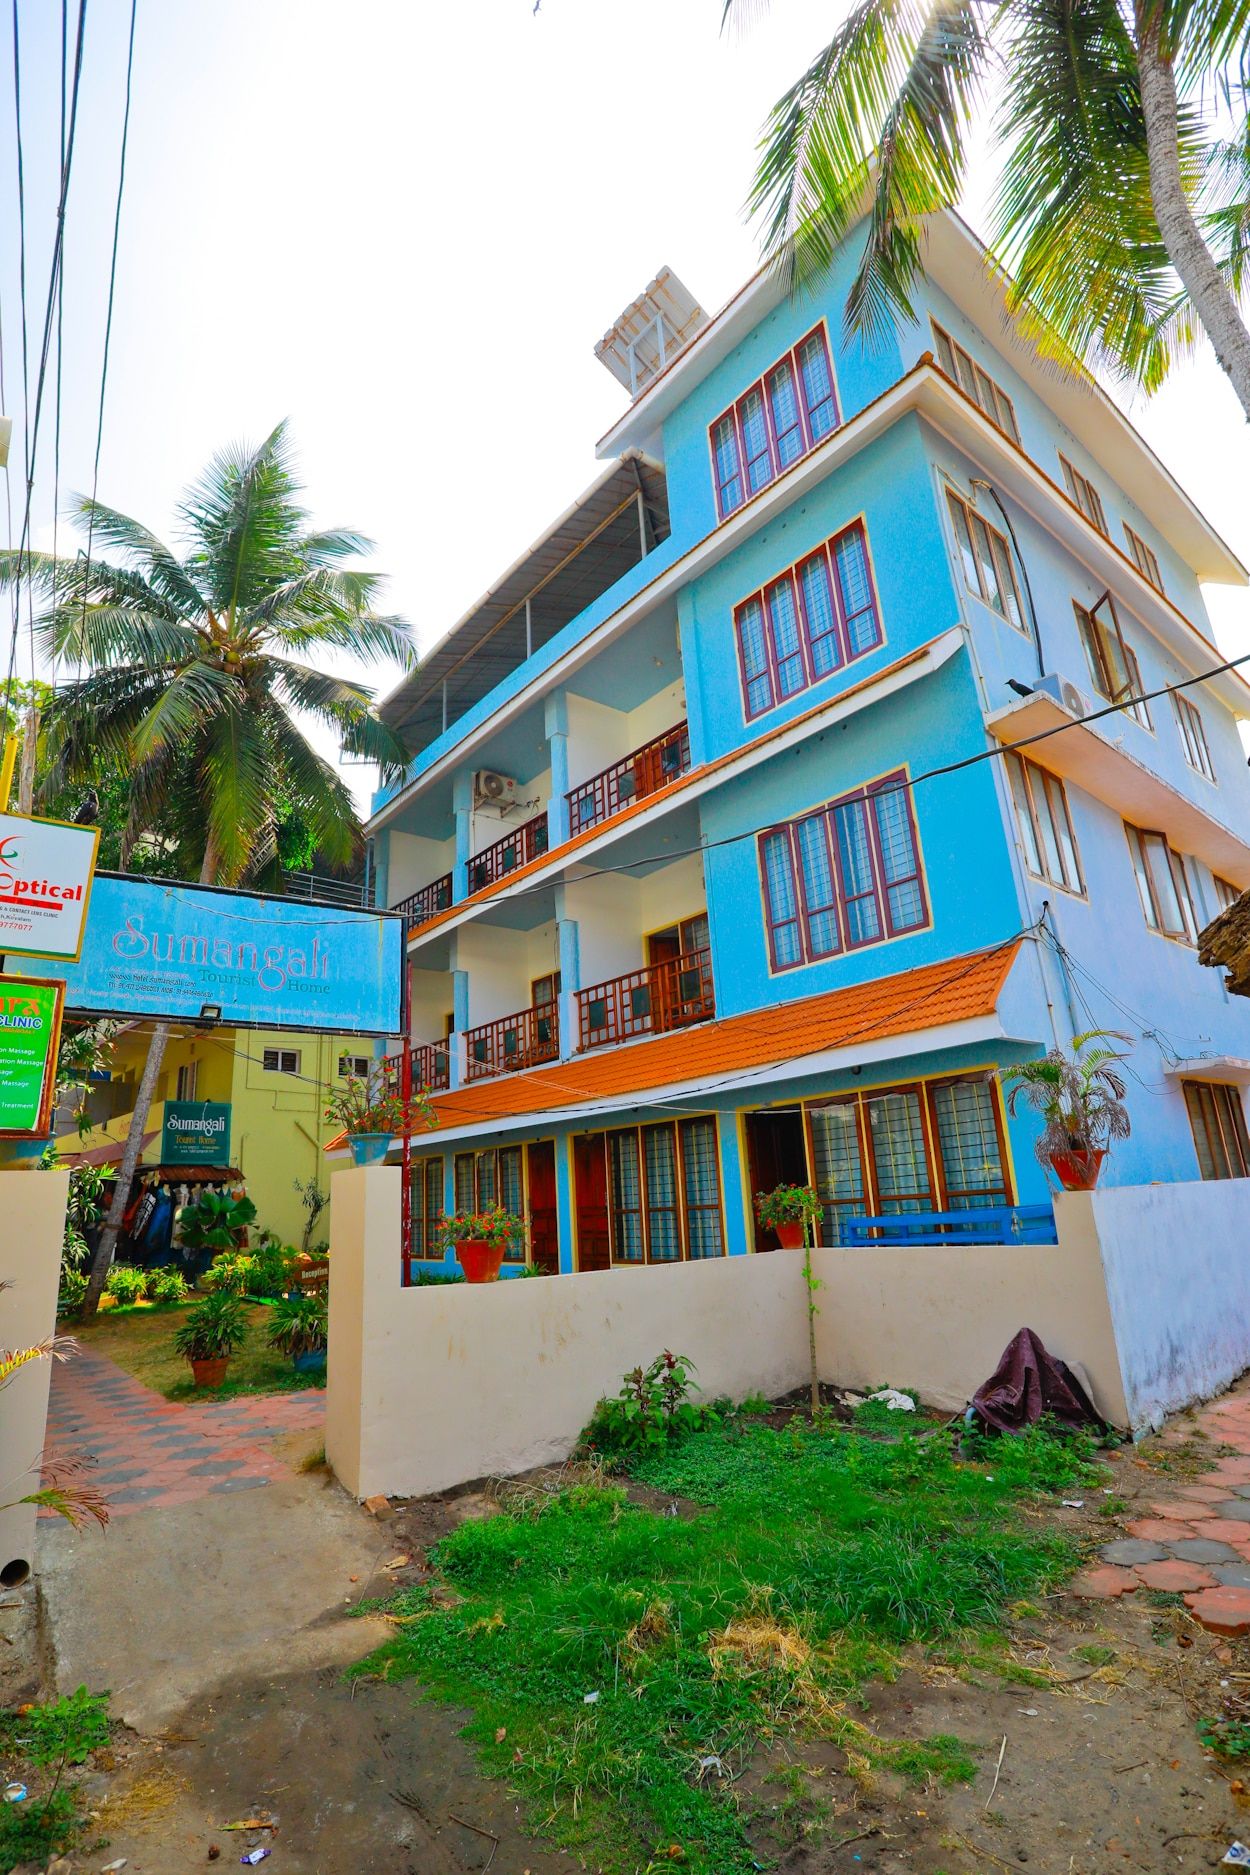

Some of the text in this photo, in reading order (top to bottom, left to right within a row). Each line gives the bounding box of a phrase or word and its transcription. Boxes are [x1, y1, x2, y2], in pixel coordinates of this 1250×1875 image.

[0, 873, 83, 901] Optical
[9, 907, 30, 915] CONTACT
[113, 915, 328, 991] Sumangali
[199, 969, 256, 988] Tourist
[287, 979, 331, 995] Home
[8, 1047, 35, 1055] Massage
[16, 1058, 43, 1066] Massage
[167, 1114, 225, 1136] Sumangali
